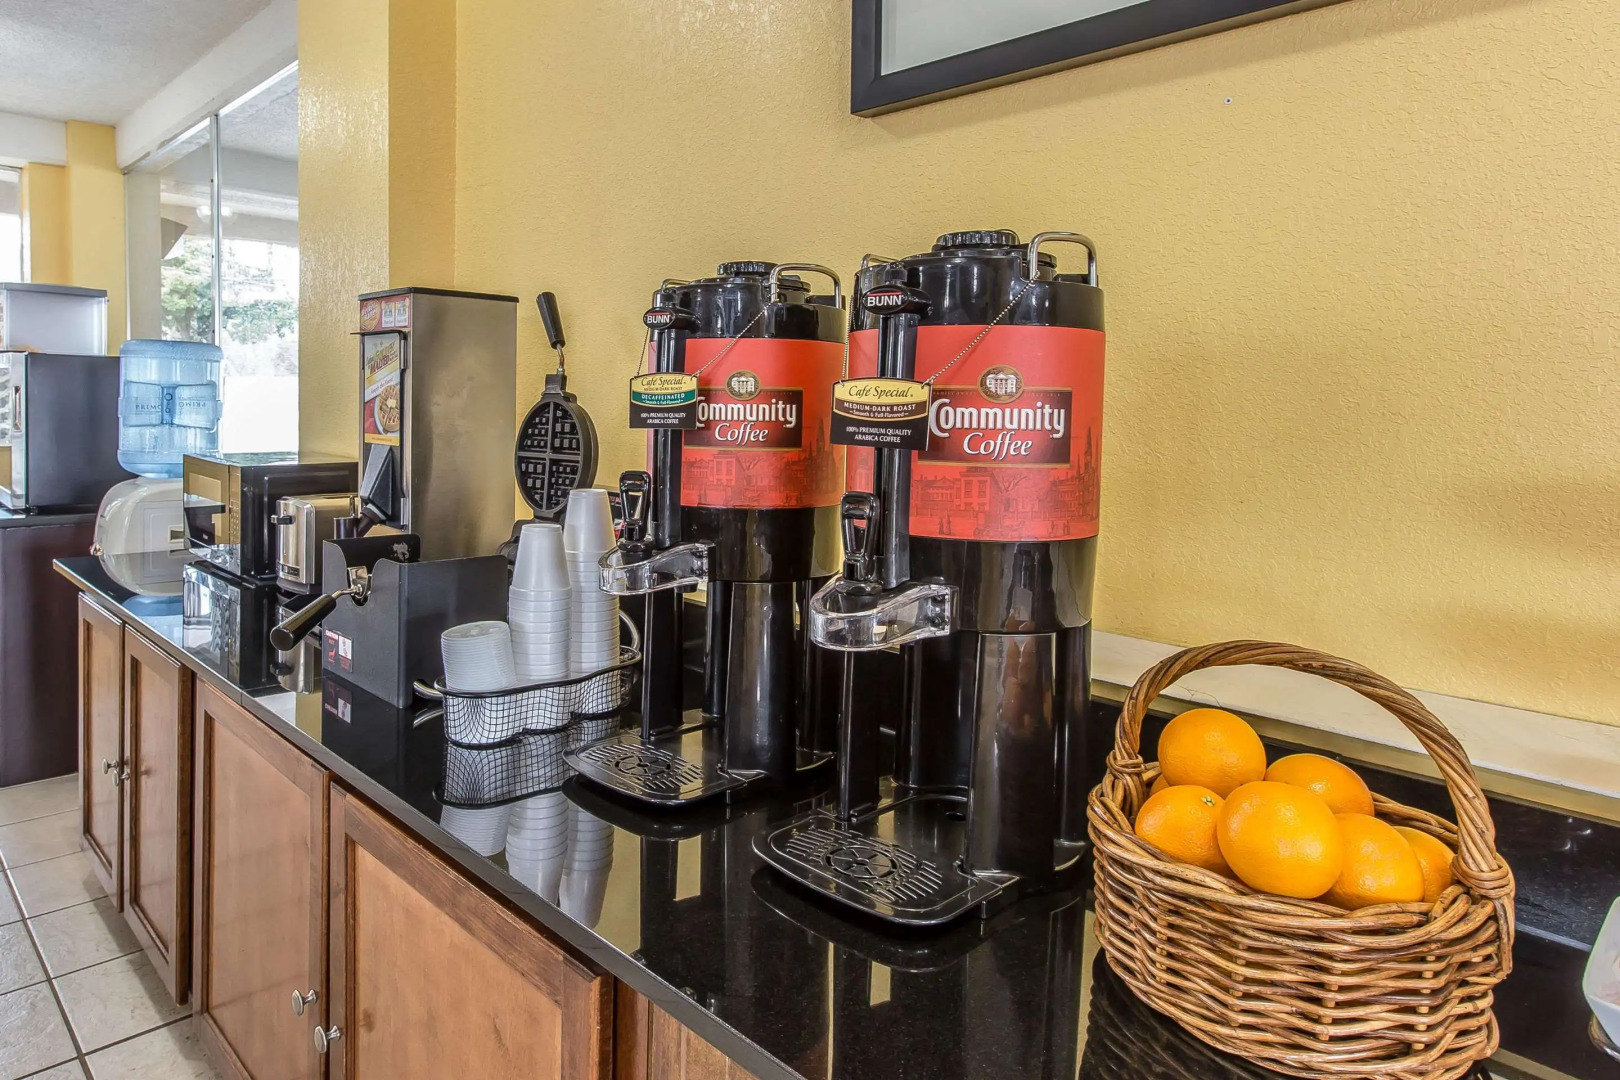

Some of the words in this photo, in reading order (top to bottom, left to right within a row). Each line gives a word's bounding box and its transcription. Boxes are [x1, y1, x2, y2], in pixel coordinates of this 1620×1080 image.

[867, 296, 902, 306] BUNN
[646, 314, 670, 324] BUNN
[641, 376, 658, 386] Café
[658, 376, 684, 387] Special
[848, 385, 872, 399] Café
[872, 386, 911, 399] Special
[844, 402, 891, 412] MEDIUM-DARK
[928, 398, 1066, 438] Community
[714, 422, 768, 445] Coffee
[963, 431, 1032, 460] Coffee
